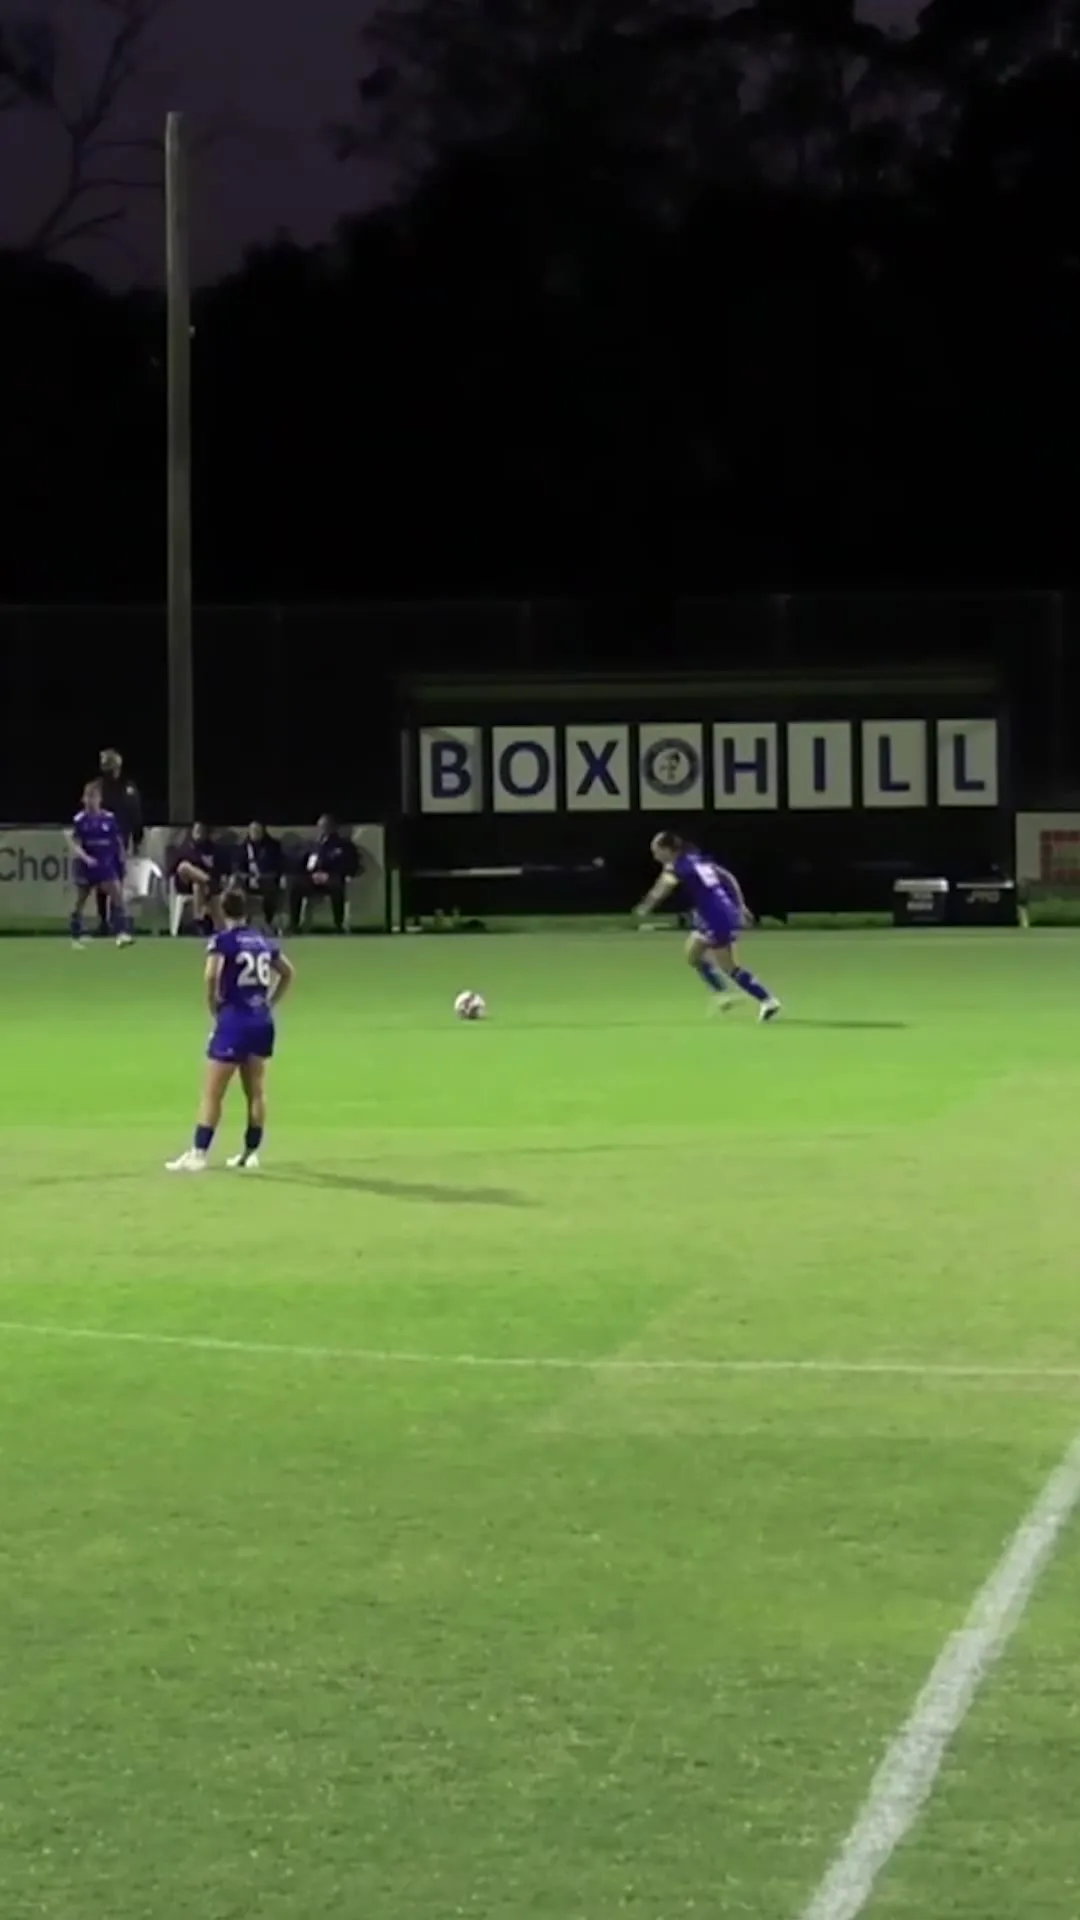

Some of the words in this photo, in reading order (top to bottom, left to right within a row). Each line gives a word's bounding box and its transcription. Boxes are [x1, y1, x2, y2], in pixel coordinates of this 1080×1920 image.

[430, 739, 621, 798] BOX
[723, 734, 986, 795] HILL
[235, 950, 272, 986] 26
